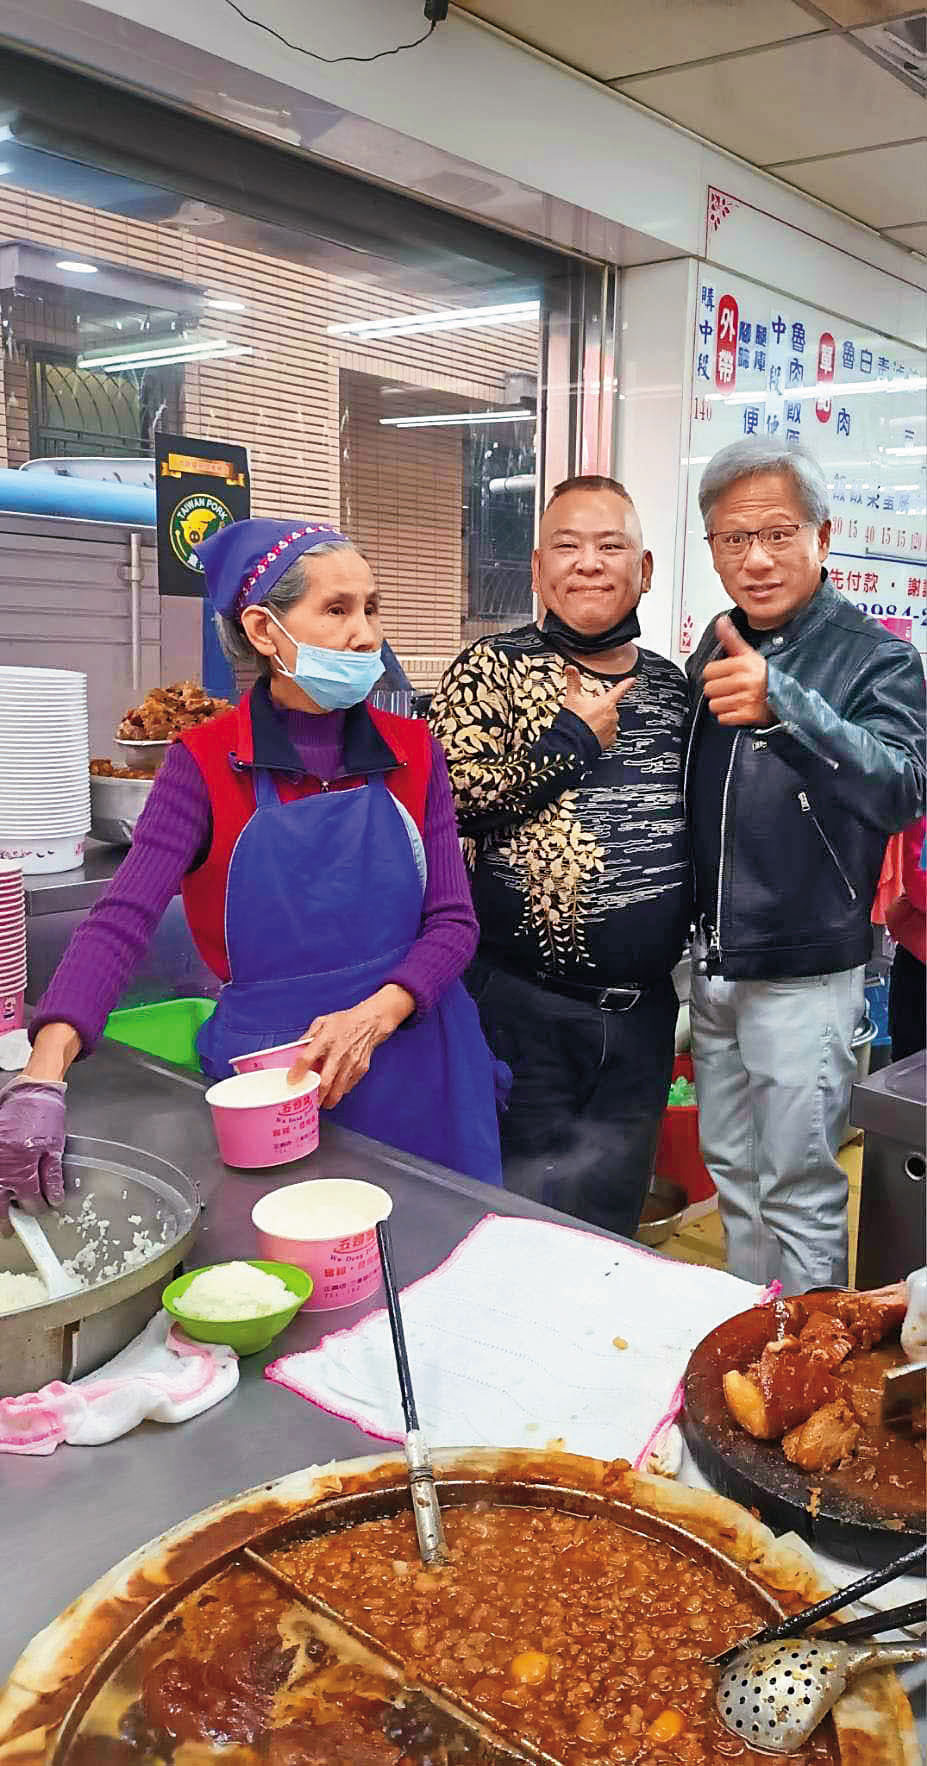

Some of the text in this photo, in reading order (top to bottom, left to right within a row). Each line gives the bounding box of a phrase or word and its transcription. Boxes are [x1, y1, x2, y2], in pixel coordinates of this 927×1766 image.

[720, 307, 736, 384] 外帶
[177, 499, 228, 521] TAIWAN PORK
[882, 527, 891, 545] 15
[827, 568, 879, 593] 先付款
